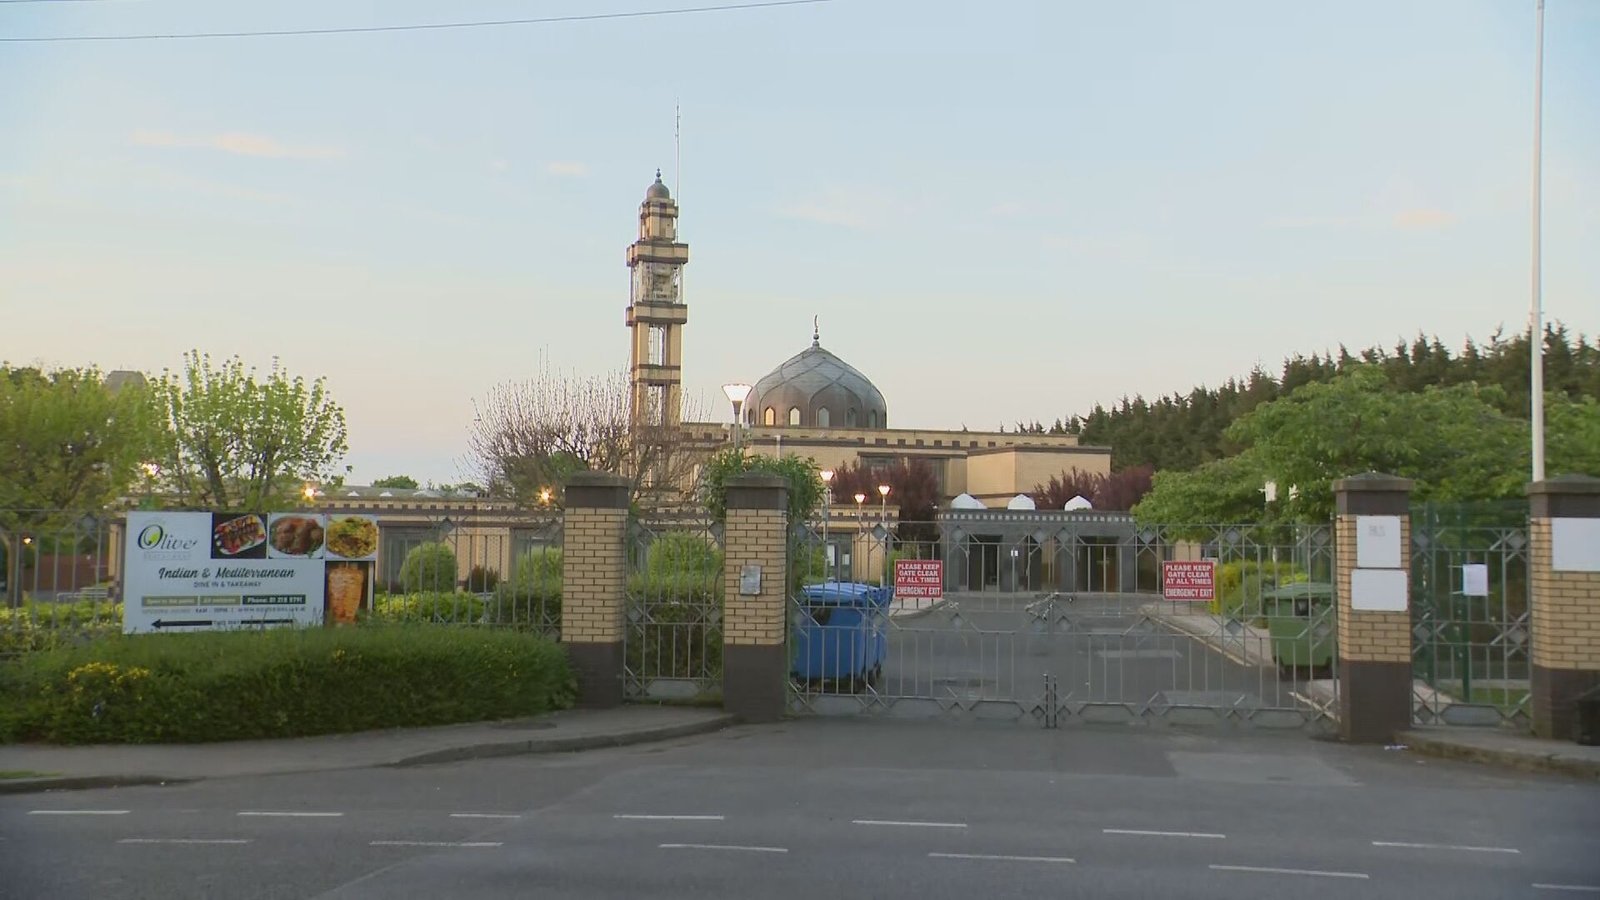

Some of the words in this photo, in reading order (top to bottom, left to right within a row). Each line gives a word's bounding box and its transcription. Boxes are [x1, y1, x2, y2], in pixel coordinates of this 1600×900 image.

[137, 524, 198, 550] Olive
[158, 567, 199, 579] Indian
[202, 567, 211, 578] &
[215, 567, 296, 579] Mediterranean
[896, 586, 928, 595] EMERGENCY
[928, 586, 940, 595] EXIT
[1165, 588, 1199, 597] EMERGENCY
[1199, 588, 1212, 597] EXIT
